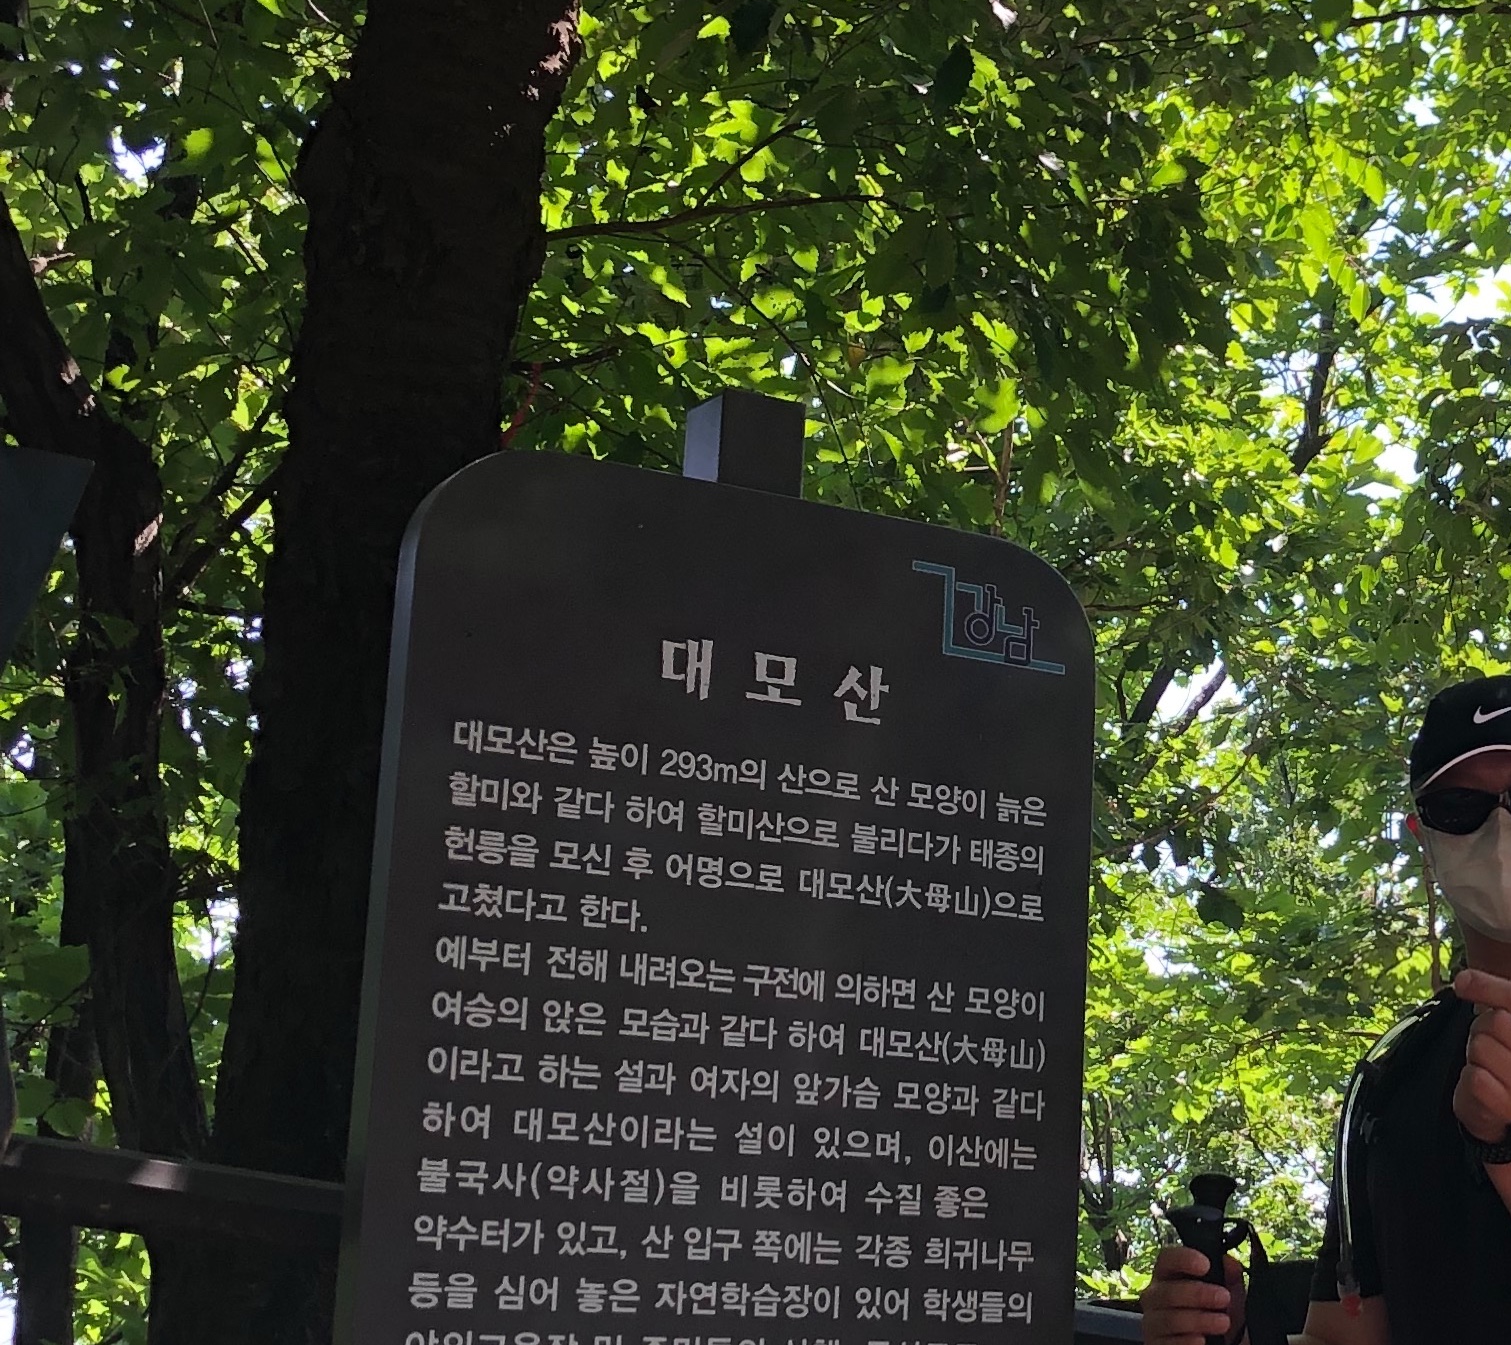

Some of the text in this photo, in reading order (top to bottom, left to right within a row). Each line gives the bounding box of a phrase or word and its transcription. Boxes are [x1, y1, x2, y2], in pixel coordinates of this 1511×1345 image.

[453, 720, 1047, 826] 대모산은 높이 293m의 산으로 산 모양이 늙은
[449, 771, 1043, 875] 할미와 같다 하여 할미산으로 불리다가 태종의
[445, 826, 539, 868] 헌릉을
[549, 841, 611, 876] 모신
[623, 847, 653, 880] 후
[666, 854, 784, 892] 어명으로
[438, 883, 647, 932] 고쳤다고 한다.
[436, 936, 1044, 1022] 예부터 전해 내려오는 구전에 의하면 산 모양이
[432, 991, 528, 1030] 여승의
[543, 1000, 606, 1036] 앉은
[619, 1008, 710, 1044] 모습과
[720, 1015, 777, 1049] 같다
[789, 1021, 844, 1055] 하여
[428, 1046, 1045, 1121] 이라고 하는 설과 여자의 앞가슴 모양과 같다
[423, 1102, 1037, 1170] 하여 대모산이라는 설이 있으며, 이산에는
[417, 1158, 988, 1219] 불국사(약사절)을 비롯하여 수질 좋은
[414, 1215, 1034, 1272] 약수터가 있고, 산 입구 쪽에는 각종 희귀나무
[408, 1272, 1032, 1324] 등을 심어 놓은 자연학습장이 있어 학생들의
